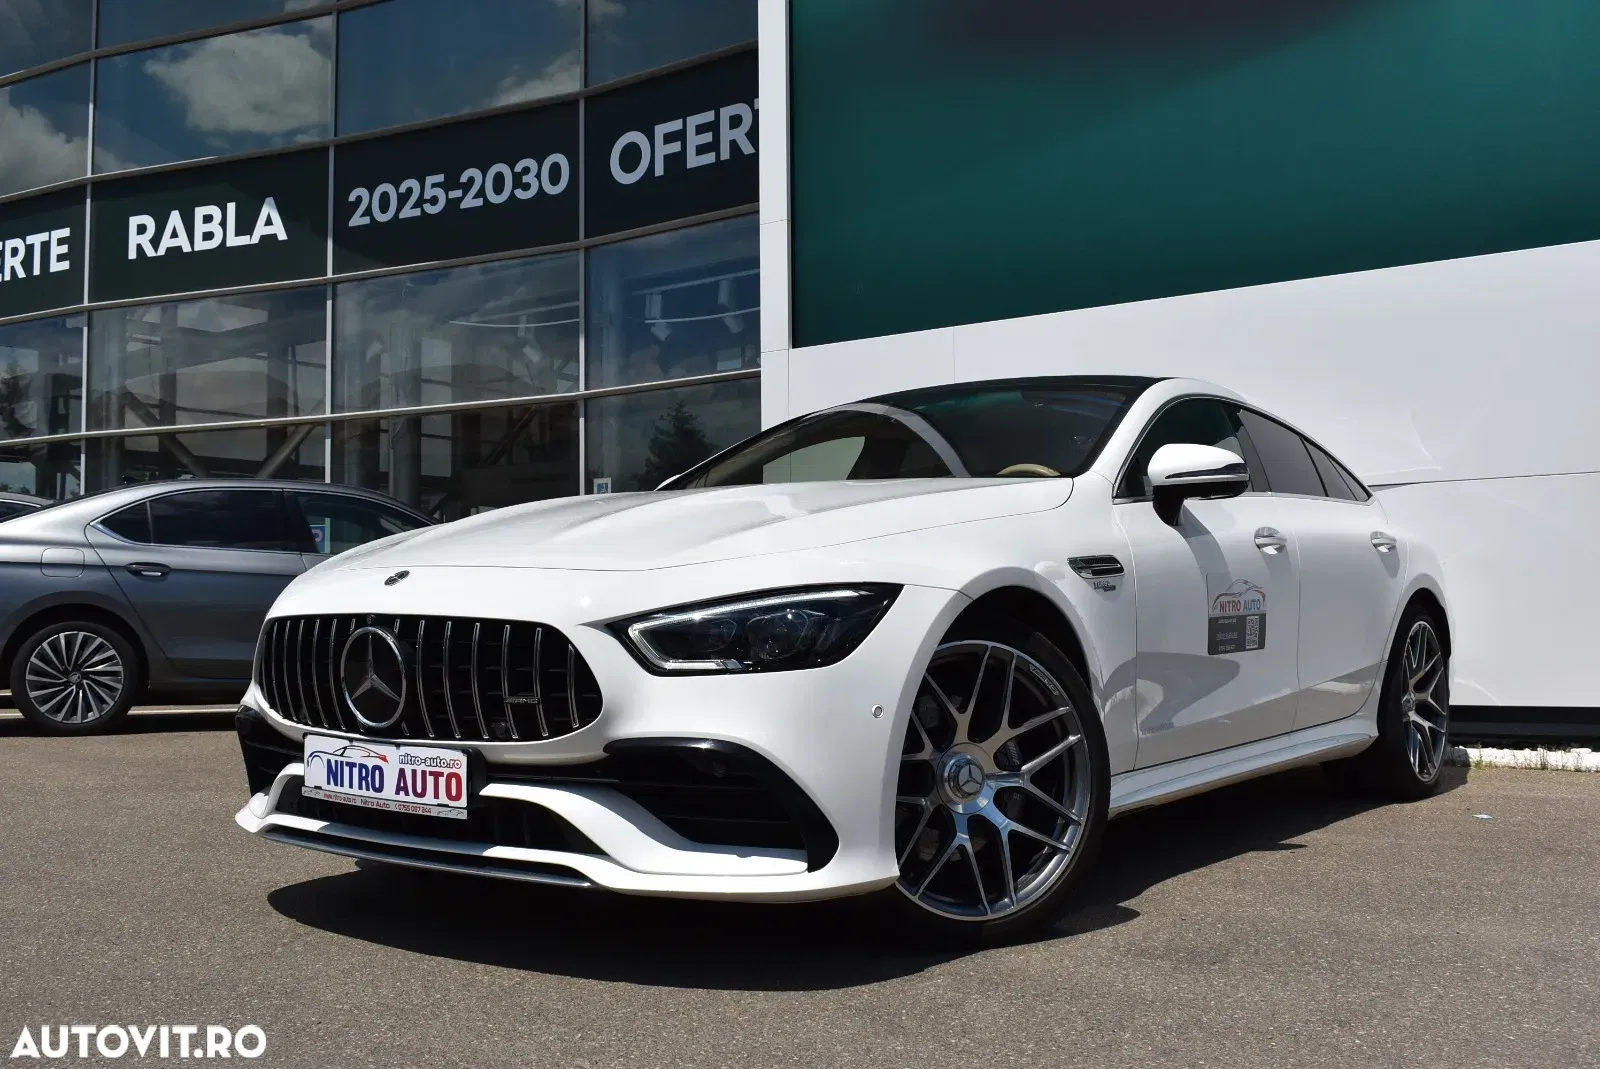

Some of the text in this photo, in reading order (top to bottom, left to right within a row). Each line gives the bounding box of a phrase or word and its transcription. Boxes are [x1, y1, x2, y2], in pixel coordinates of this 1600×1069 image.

[0, 227, 71, 282] RTE
[127, 196, 289, 260] RABLA
[348, 152, 570, 227] 2025-2030
[1219, 599, 1261, 613] NITRO AUTO
[398, 752, 463, 769] nitro-auto.ro
[326, 758, 463, 802] NITRO AUTO
[360, 798, 375, 807] Nitro
[375, 800, 391, 809] Auto
